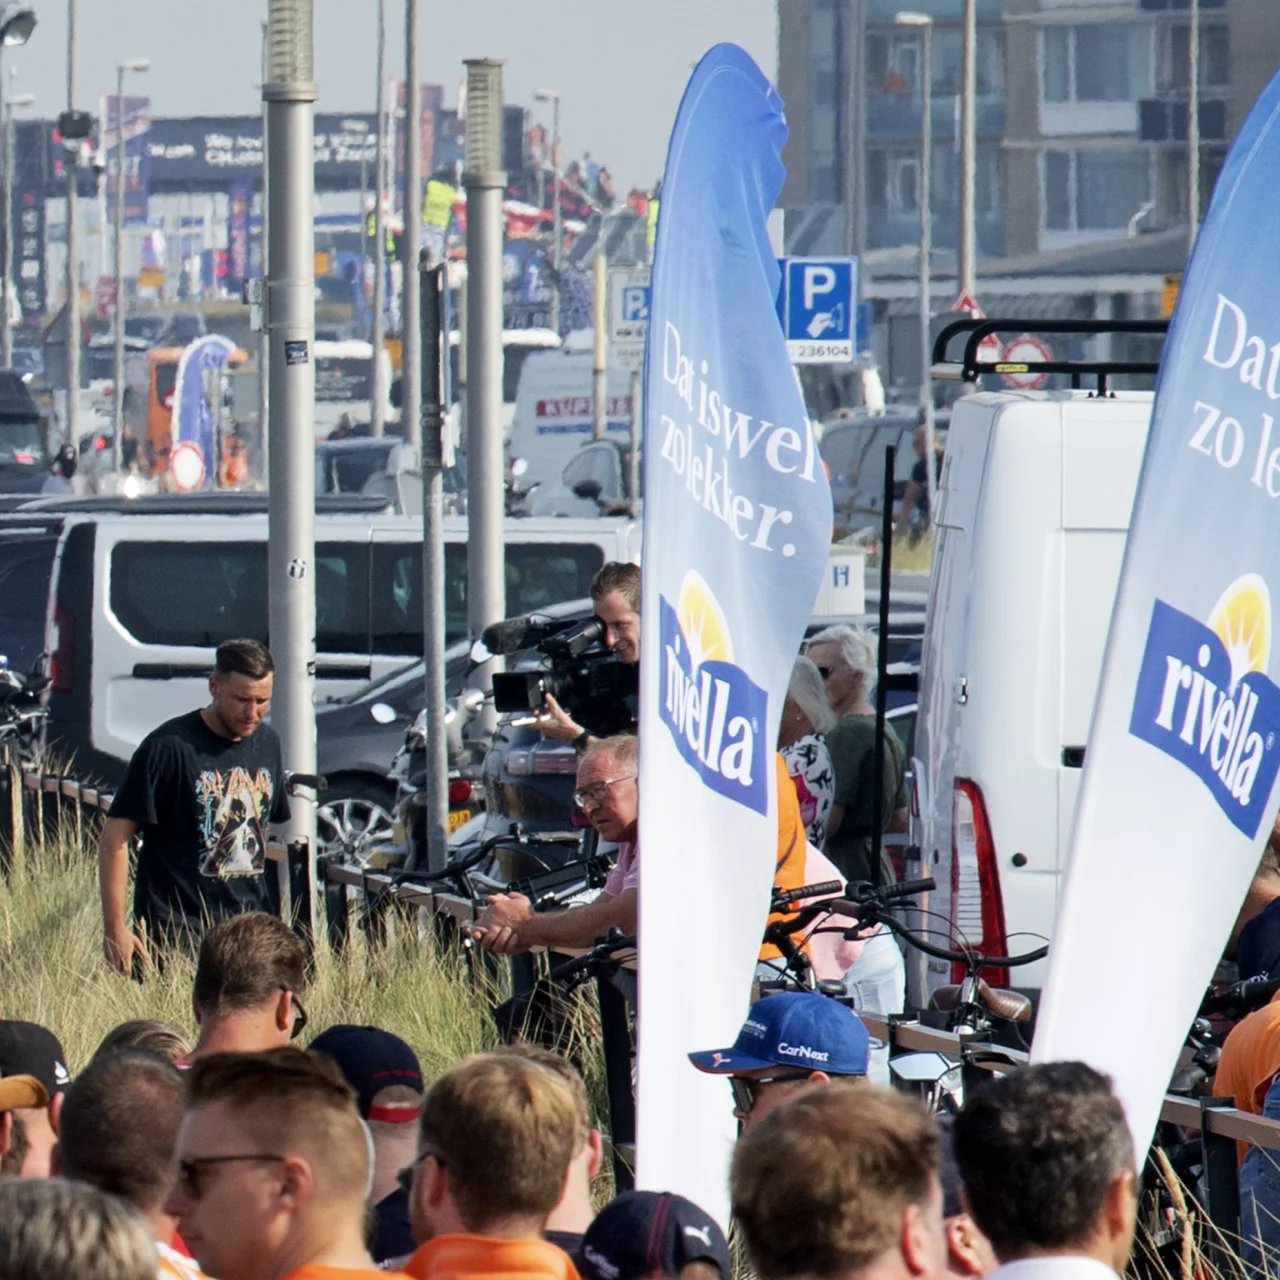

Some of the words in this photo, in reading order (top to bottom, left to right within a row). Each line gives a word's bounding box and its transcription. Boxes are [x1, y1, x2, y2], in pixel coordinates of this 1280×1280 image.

[804, 266, 836, 310] P
[663, 319, 694, 410] Dat
[697, 360, 720, 438] is
[720, 405, 816, 484] wel
[1189, 400, 1245, 470] zo
[661, 413, 685, 475] zo
[686, 435, 796, 558] lekker.
[665, 640, 753, 790] rivella
[1155, 643, 1265, 806] rivella
[777, 1042, 829, 1062] CarNext
